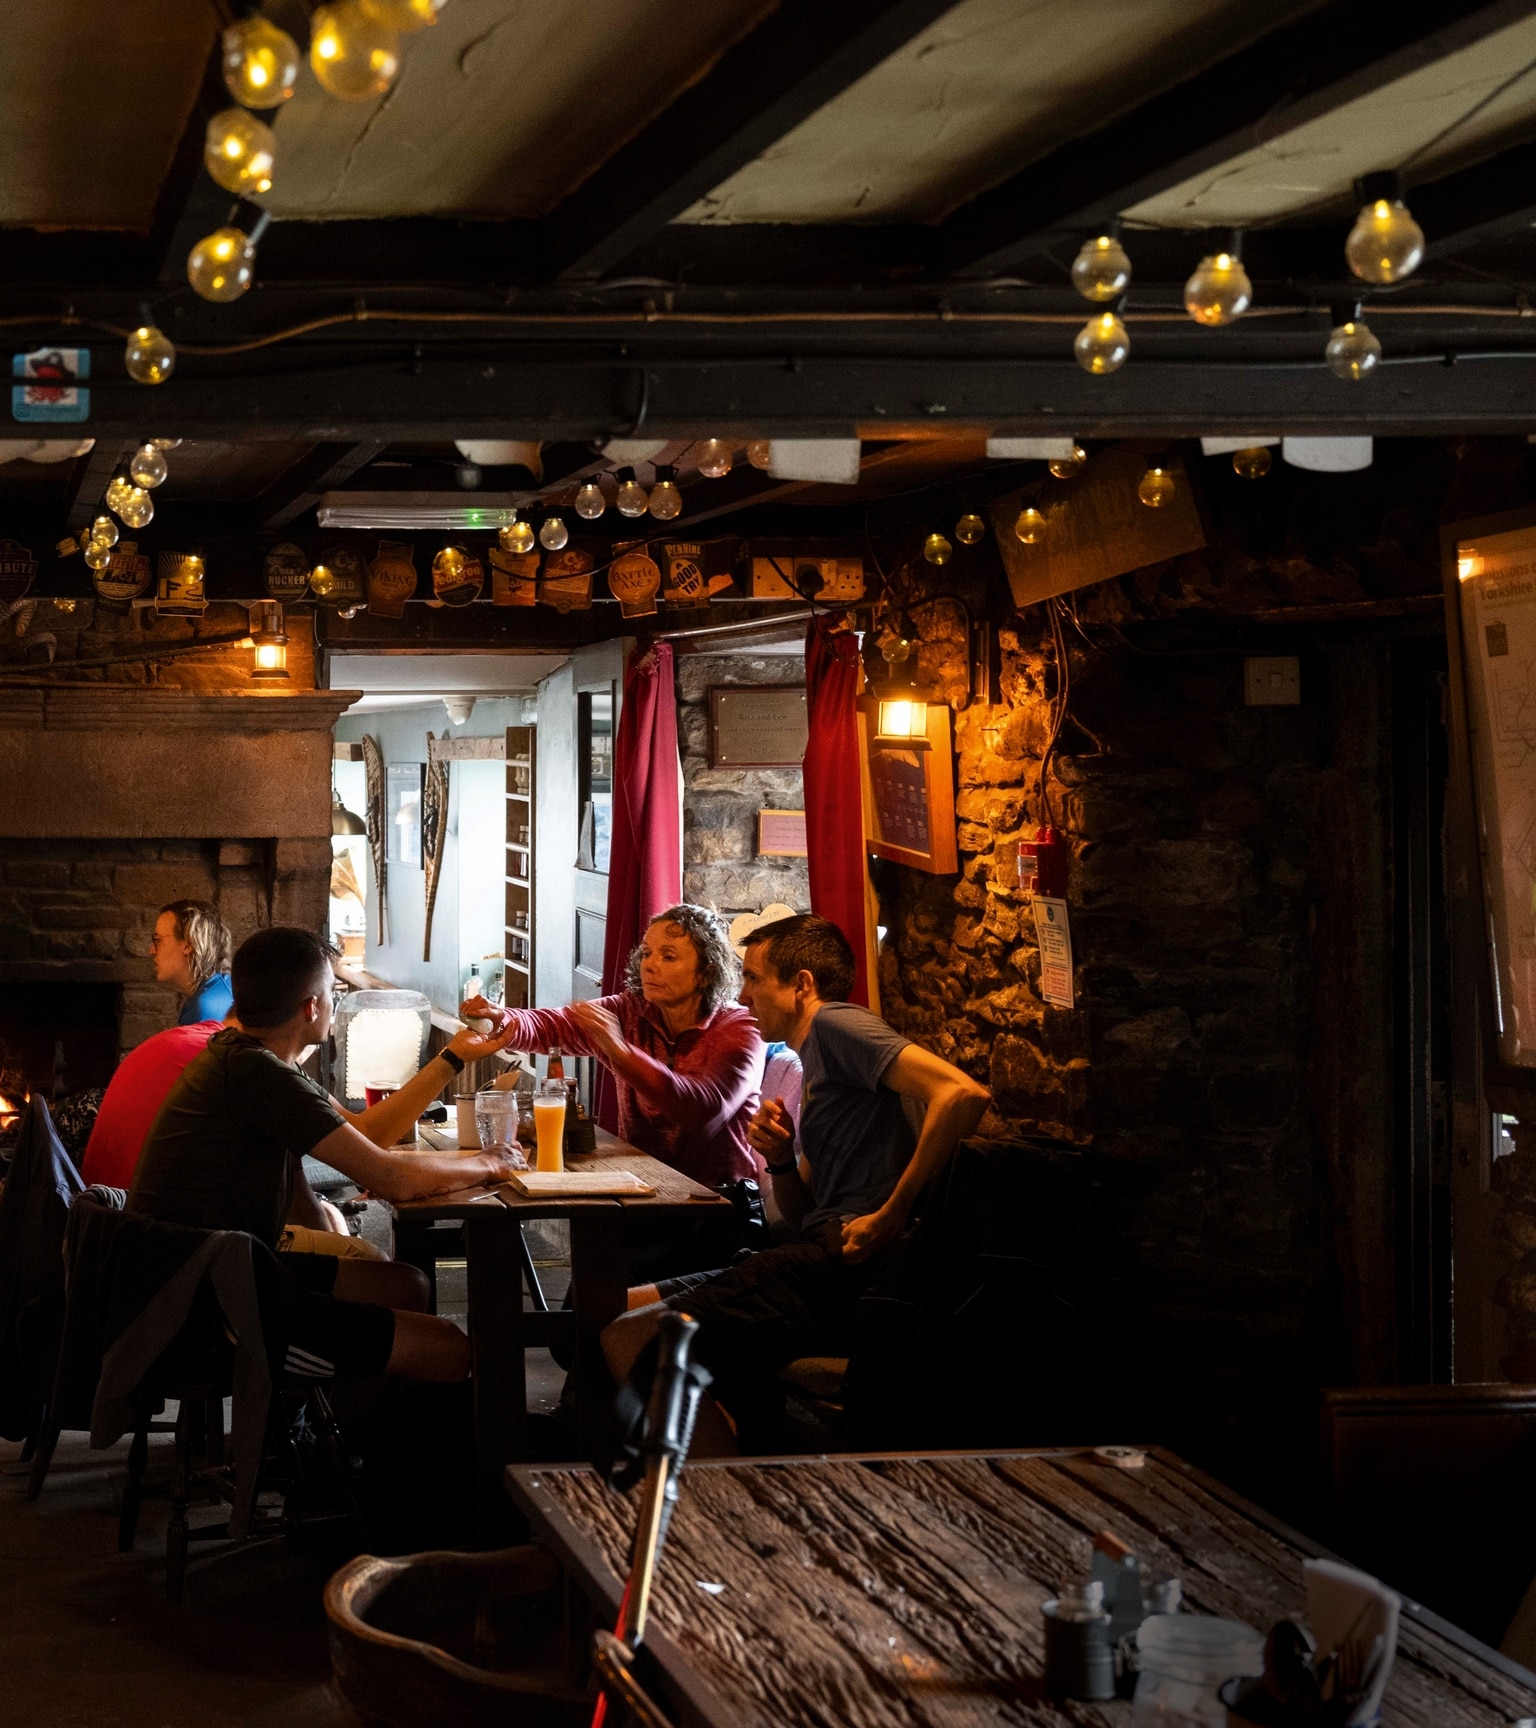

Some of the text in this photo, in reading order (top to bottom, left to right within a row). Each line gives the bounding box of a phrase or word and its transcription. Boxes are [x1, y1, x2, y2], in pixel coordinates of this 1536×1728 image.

[672, 564, 697, 587] GOOD
[682, 577, 701, 595] TRY
[1479, 581, 1533, 600] Yorkshire
